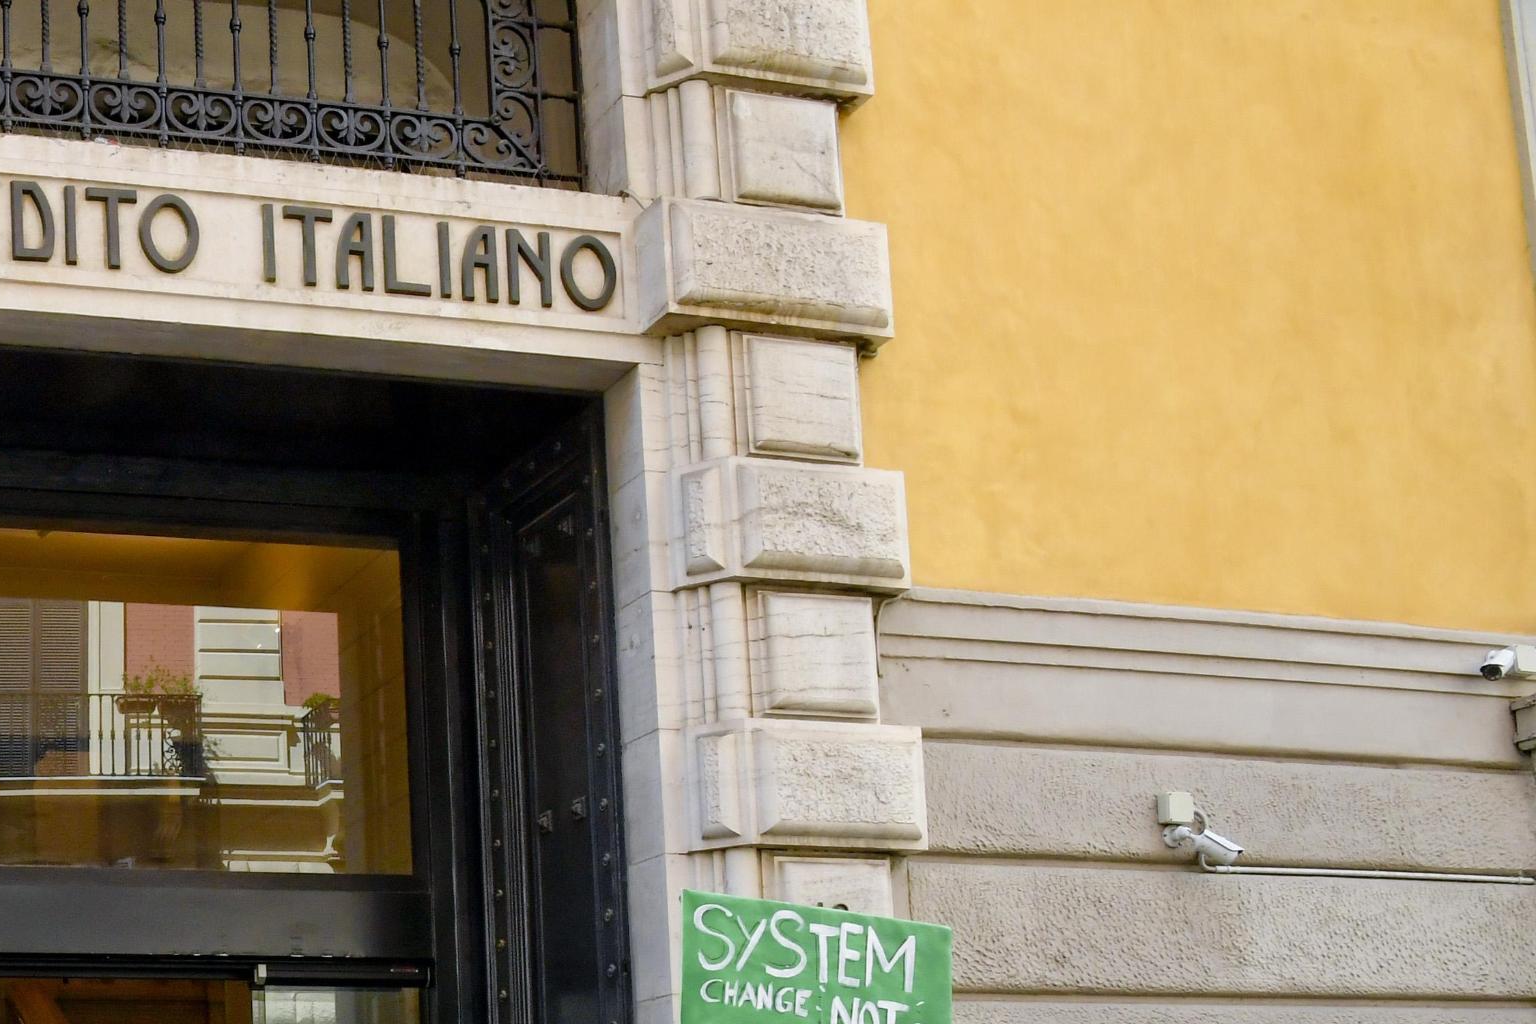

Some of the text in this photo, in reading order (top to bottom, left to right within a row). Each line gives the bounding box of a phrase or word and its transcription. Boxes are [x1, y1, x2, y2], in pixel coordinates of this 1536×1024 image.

[261, 202, 618, 313] ITALIANO
[693, 904, 916, 993] SYSTEM
[699, 979, 813, 1018] CHANGE
